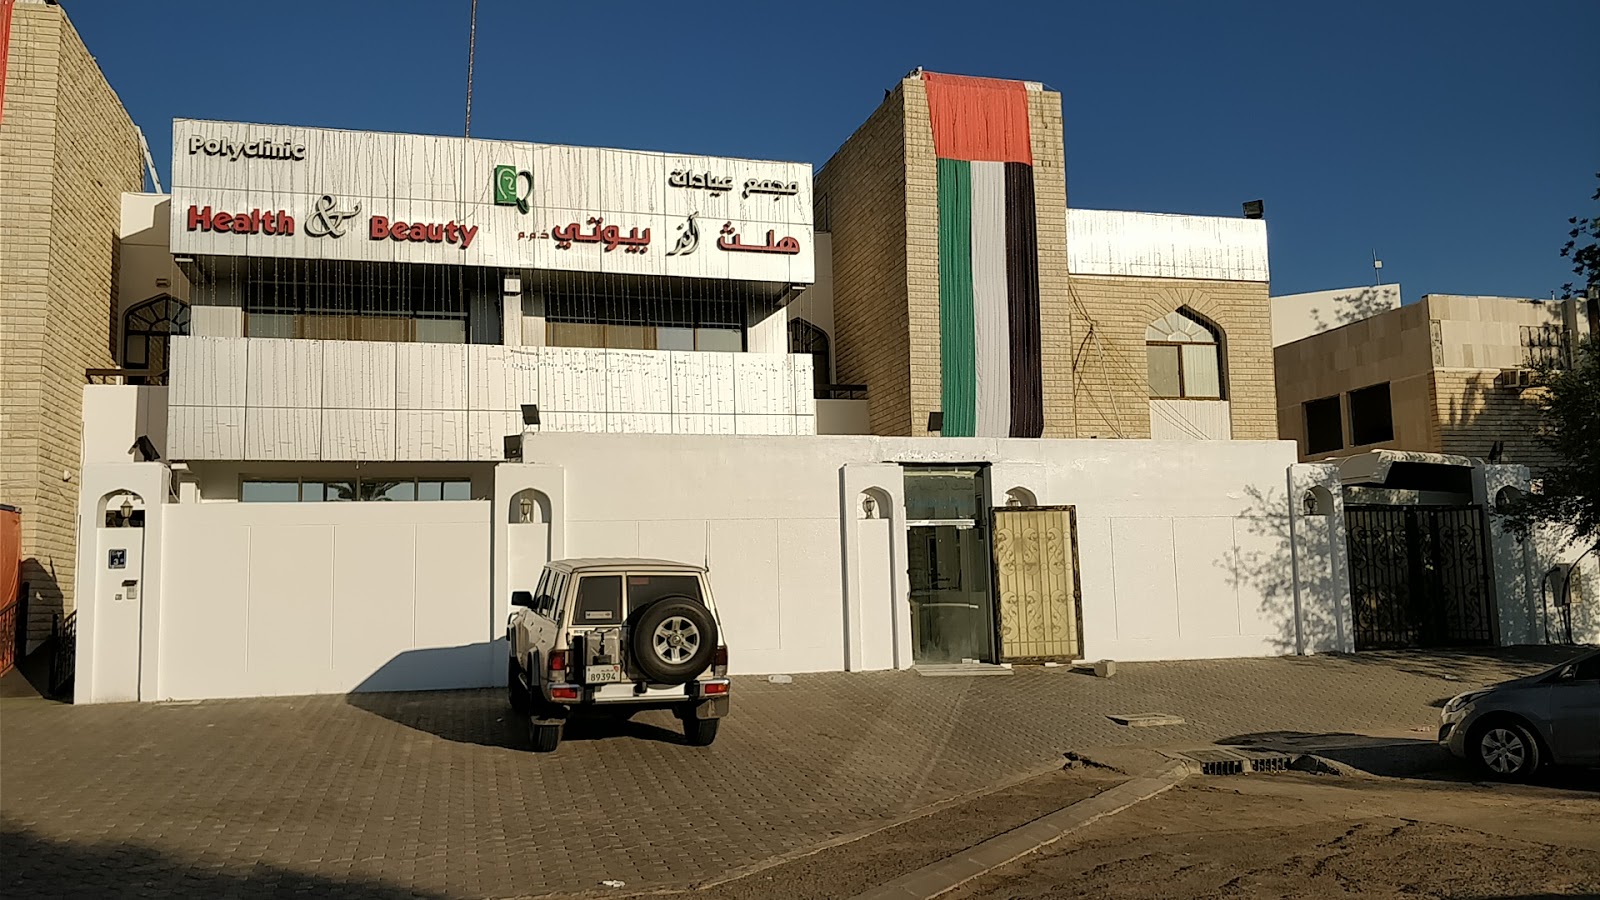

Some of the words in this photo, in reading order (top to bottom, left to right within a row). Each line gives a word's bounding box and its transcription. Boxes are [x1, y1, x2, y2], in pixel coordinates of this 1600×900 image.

[189, 135, 305, 161] Polyclinic
[668, 168, 733, 198] عيادات
[741, 173, 799, 201] مجمع
[187, 205, 295, 237] Health
[304, 194, 362, 238] &
[369, 215, 478, 250] Beauty
[552, 216, 651, 255] بيوتي
[591, 673, 616, 682] 89394
